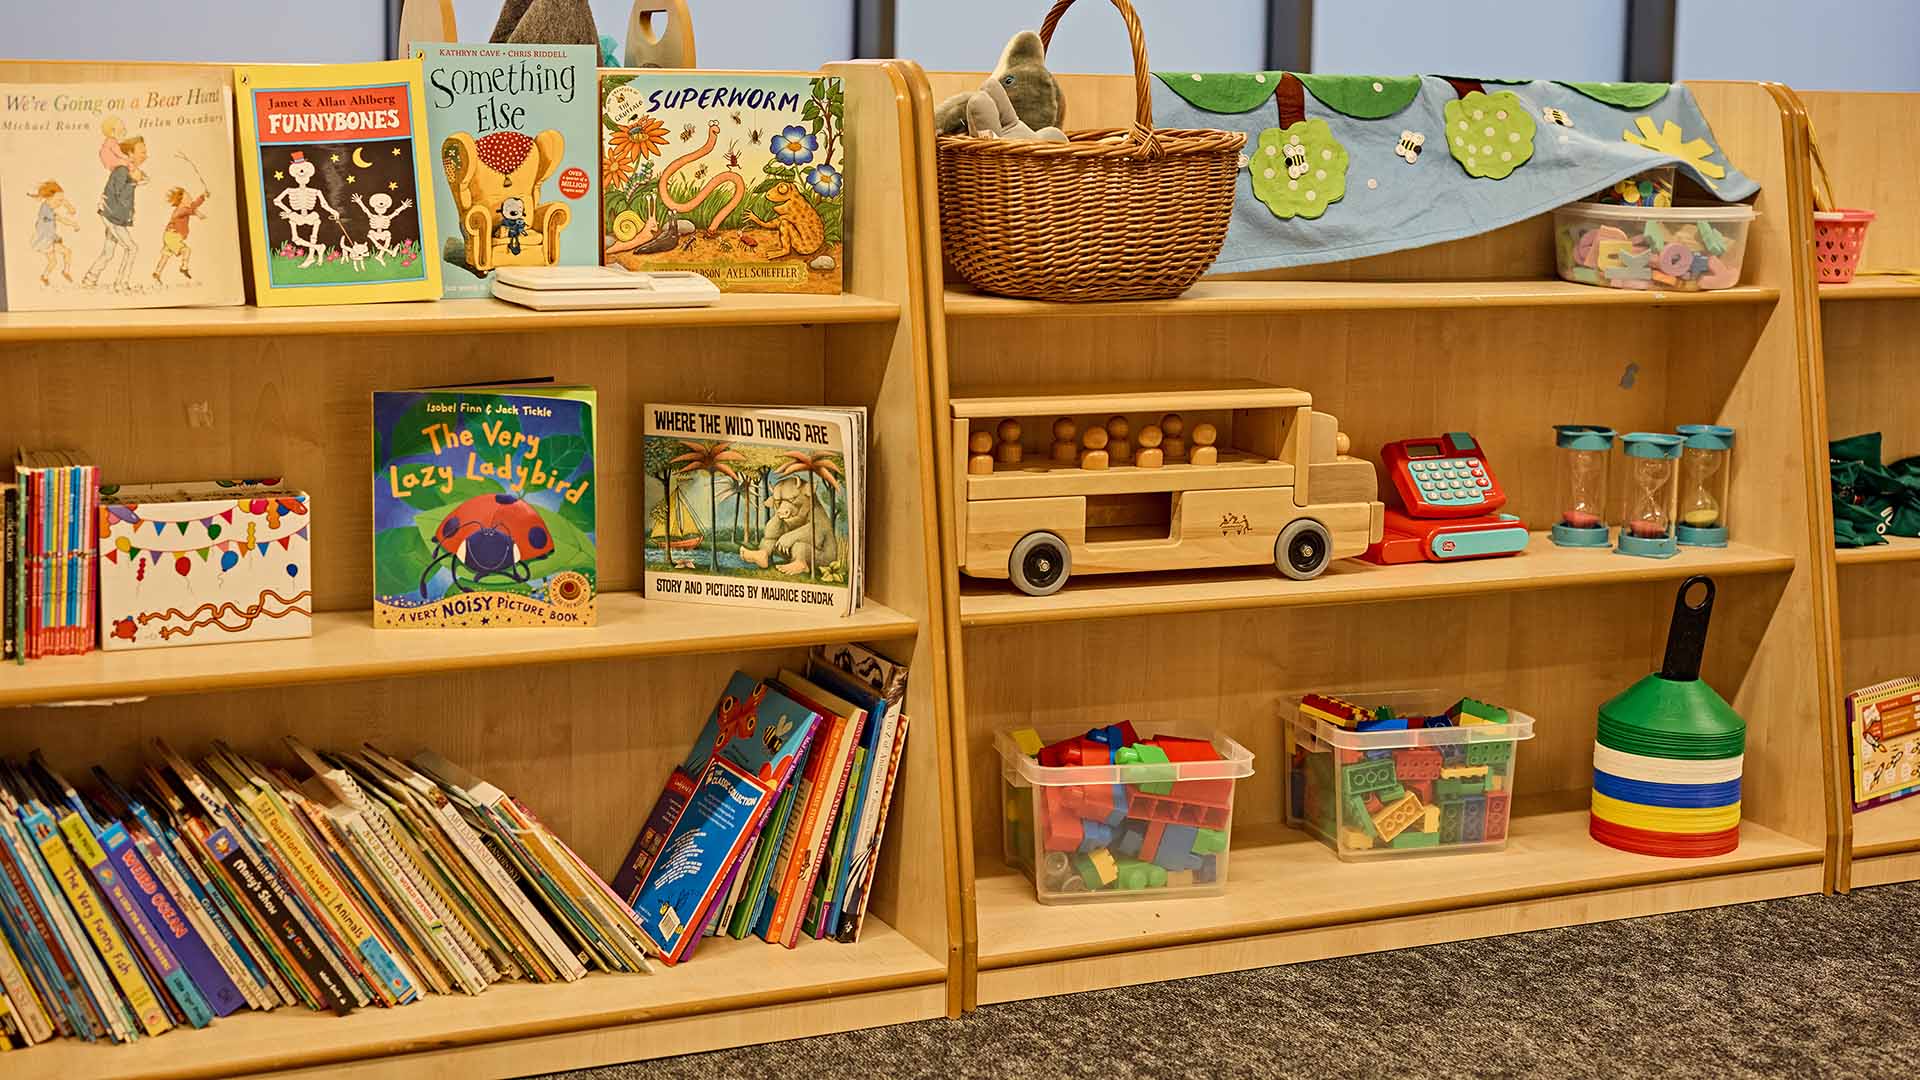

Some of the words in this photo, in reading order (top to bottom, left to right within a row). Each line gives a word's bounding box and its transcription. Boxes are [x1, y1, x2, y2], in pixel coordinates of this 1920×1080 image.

[439, 49, 477, 57] KATHRYN
[508, 50, 531, 58] CHRIS
[533, 50, 567, 58] RIDDELL
[430, 60, 575, 108] Something
[6, 95, 48, 112] We're
[54, 94, 102, 114] Going
[108, 99, 125, 112] on
[130, 99, 139, 109] a
[147, 91, 182, 109] Bear
[186, 88, 220, 105] Hunt
[268, 98, 298, 110] Janet
[303, 98, 312, 107] &
[317, 97, 345, 107] Allan
[350, 95, 395, 106] Ahlberg
[477, 96, 525, 133] Else
[646, 87, 799, 113] SUPERWORM
[139, 118, 171, 129] Helen
[268, 109, 400, 134] FUNNYBONES
[726, 269, 747, 279] AXEL
[750, 267, 798, 279] SCHEFFLER
[427, 403, 456, 413] Isobel
[460, 403, 482, 413] Finn
[486, 404, 492, 415] &
[495, 404, 519, 415] Jack
[522, 405, 552, 417] Tickle
[421, 423, 474, 456] The
[482, 420, 540, 460] Very
[654, 410, 696, 433] WHERE
[698, 413, 721, 434] THE
[725, 415, 754, 437] WILD
[757, 419, 801, 442] THINGS
[804, 424, 829, 444] ARE
[390, 465, 453, 498] Lazy
[466, 452, 589, 504] Ladybird
[656, 578, 682, 594] STORY
[684, 581, 702, 595] AND
[705, 582, 744, 598] PICTURES
[748, 585, 758, 599] BY
[761, 587, 799, 603] MAURICE
[801, 590, 834, 607] SENDAK
[398, 612, 406, 623] A
[409, 608, 438, 622] VERY
[550, 610, 578, 622] BOOK
[843, 759, 851, 772] MY
[711, 777, 731, 790] CLASSIC
[728, 786, 757, 807] COLLECTION
[835, 773, 847, 798] FIRST
[825, 798, 839, 834] NURSERY
[268, 817, 302, 857] Questions
[303, 863, 332, 897] Answers
[813, 838, 826, 872] STORIES
[120, 848, 159, 895] WEIRD
[150, 890, 189, 939] OCEAN
[232, 857, 264, 892] Maisy's
[255, 888, 281, 915] Show
[254, 860, 289, 901] PIRATES
[200, 896, 216, 914] GUY
[62, 866, 82, 890] The
[72, 890, 98, 920] Very
[87, 917, 118, 953] Funny
[111, 951, 132, 975] Fish
[333, 902, 365, 939] Animals
